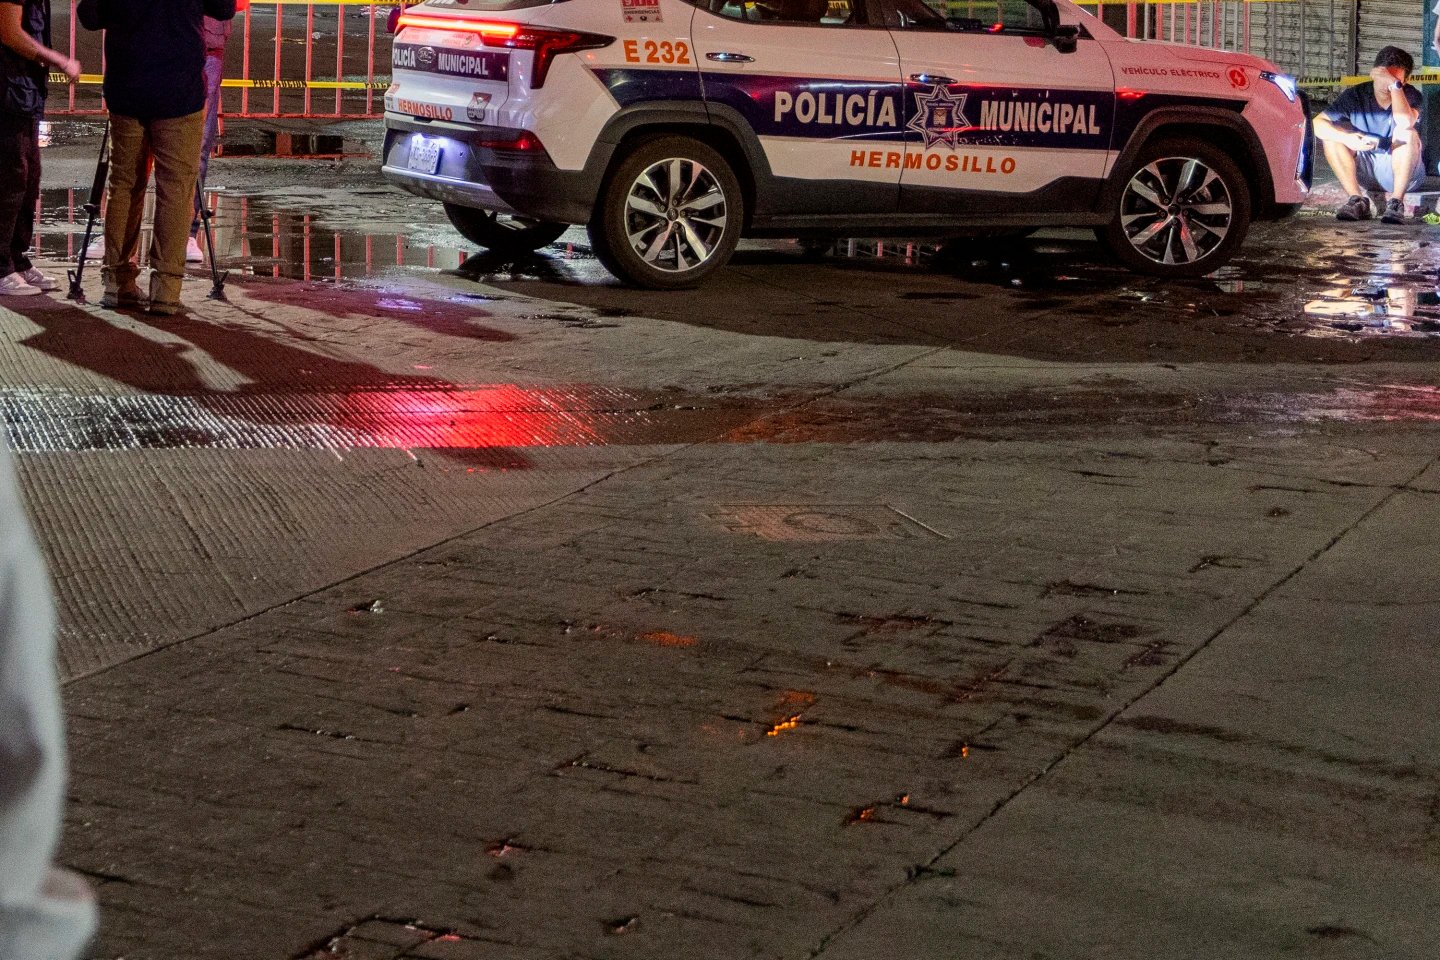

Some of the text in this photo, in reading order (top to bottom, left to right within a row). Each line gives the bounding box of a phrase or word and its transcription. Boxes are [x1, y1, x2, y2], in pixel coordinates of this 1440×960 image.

[437, 52, 489, 76] MUNICIPAL
[623, 40, 690, 64] E 232
[253, 80, 308, 88] PRECAUCION
[1121, 66, 1220, 79] VEHÍCULO ELÉCTRICO
[397, 97, 453, 121] HERMOSILLO
[774, 90, 1101, 135] POLICÍA MUNICIPAL
[849, 150, 1016, 174] HERMOSILLO
